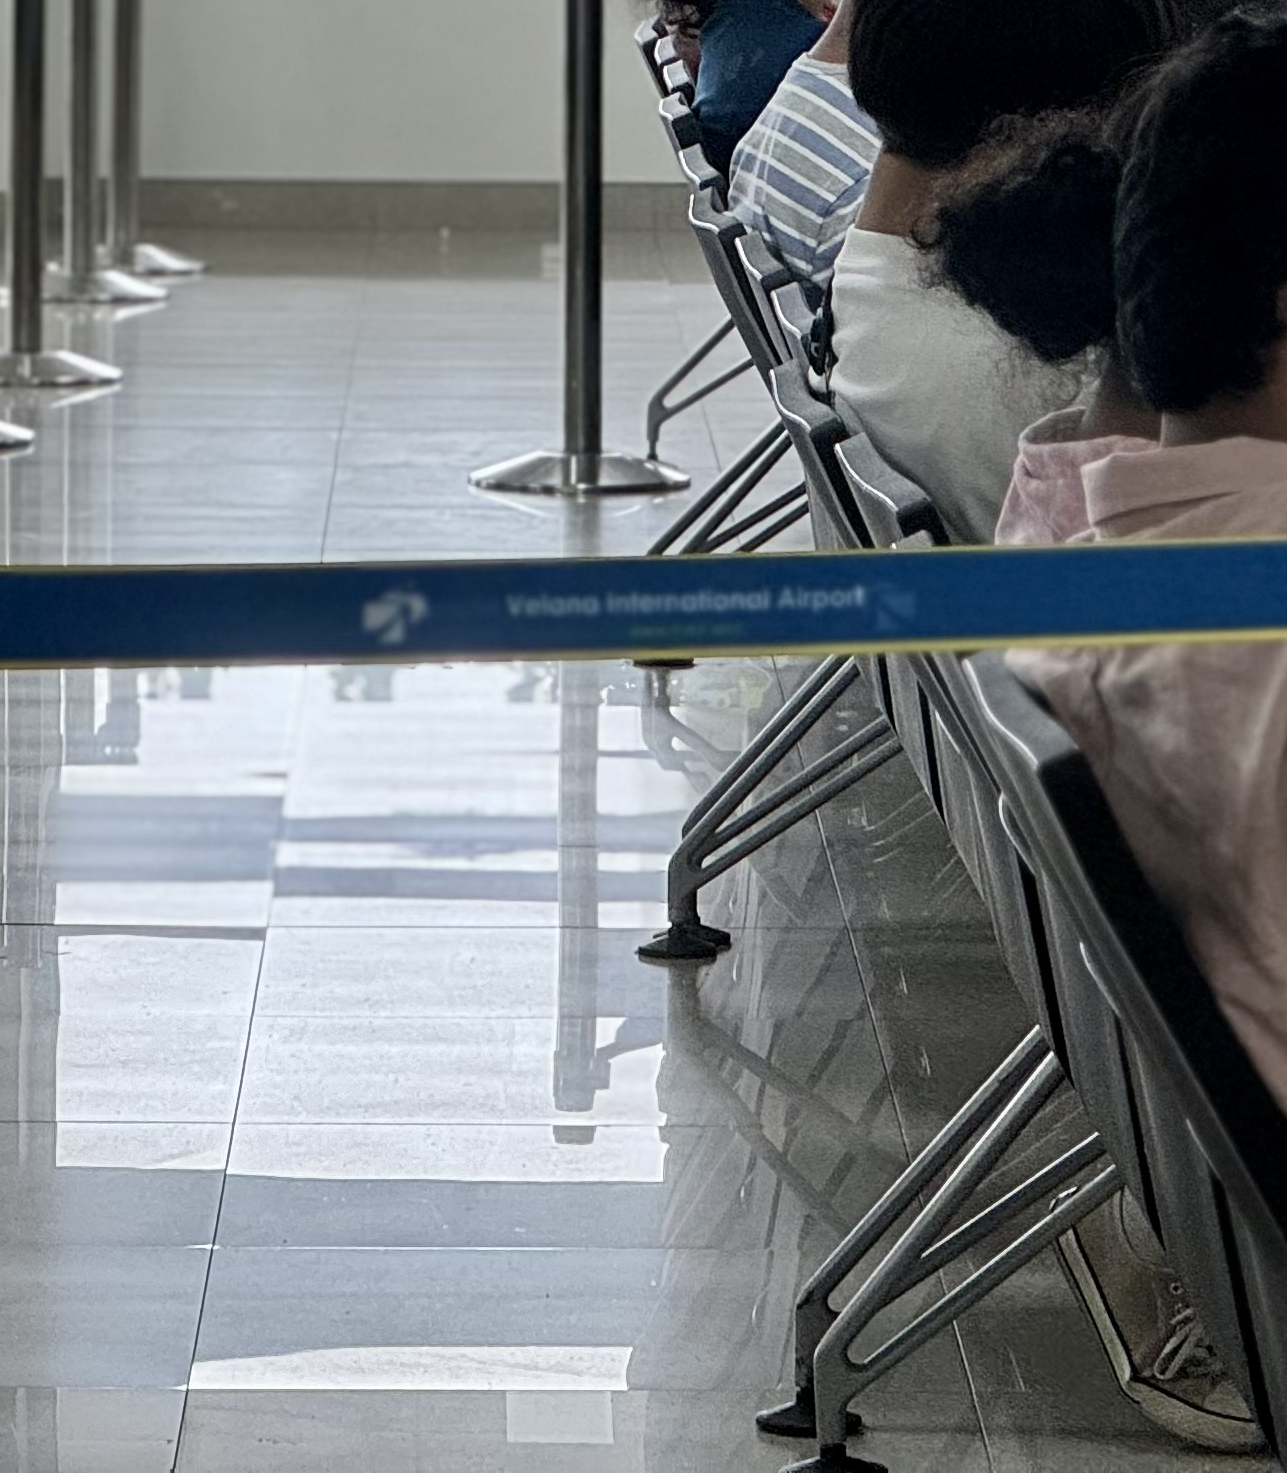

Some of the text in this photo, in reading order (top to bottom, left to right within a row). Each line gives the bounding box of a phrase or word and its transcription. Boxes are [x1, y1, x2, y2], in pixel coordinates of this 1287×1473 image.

[505, 583, 866, 617] Velana International Airport
